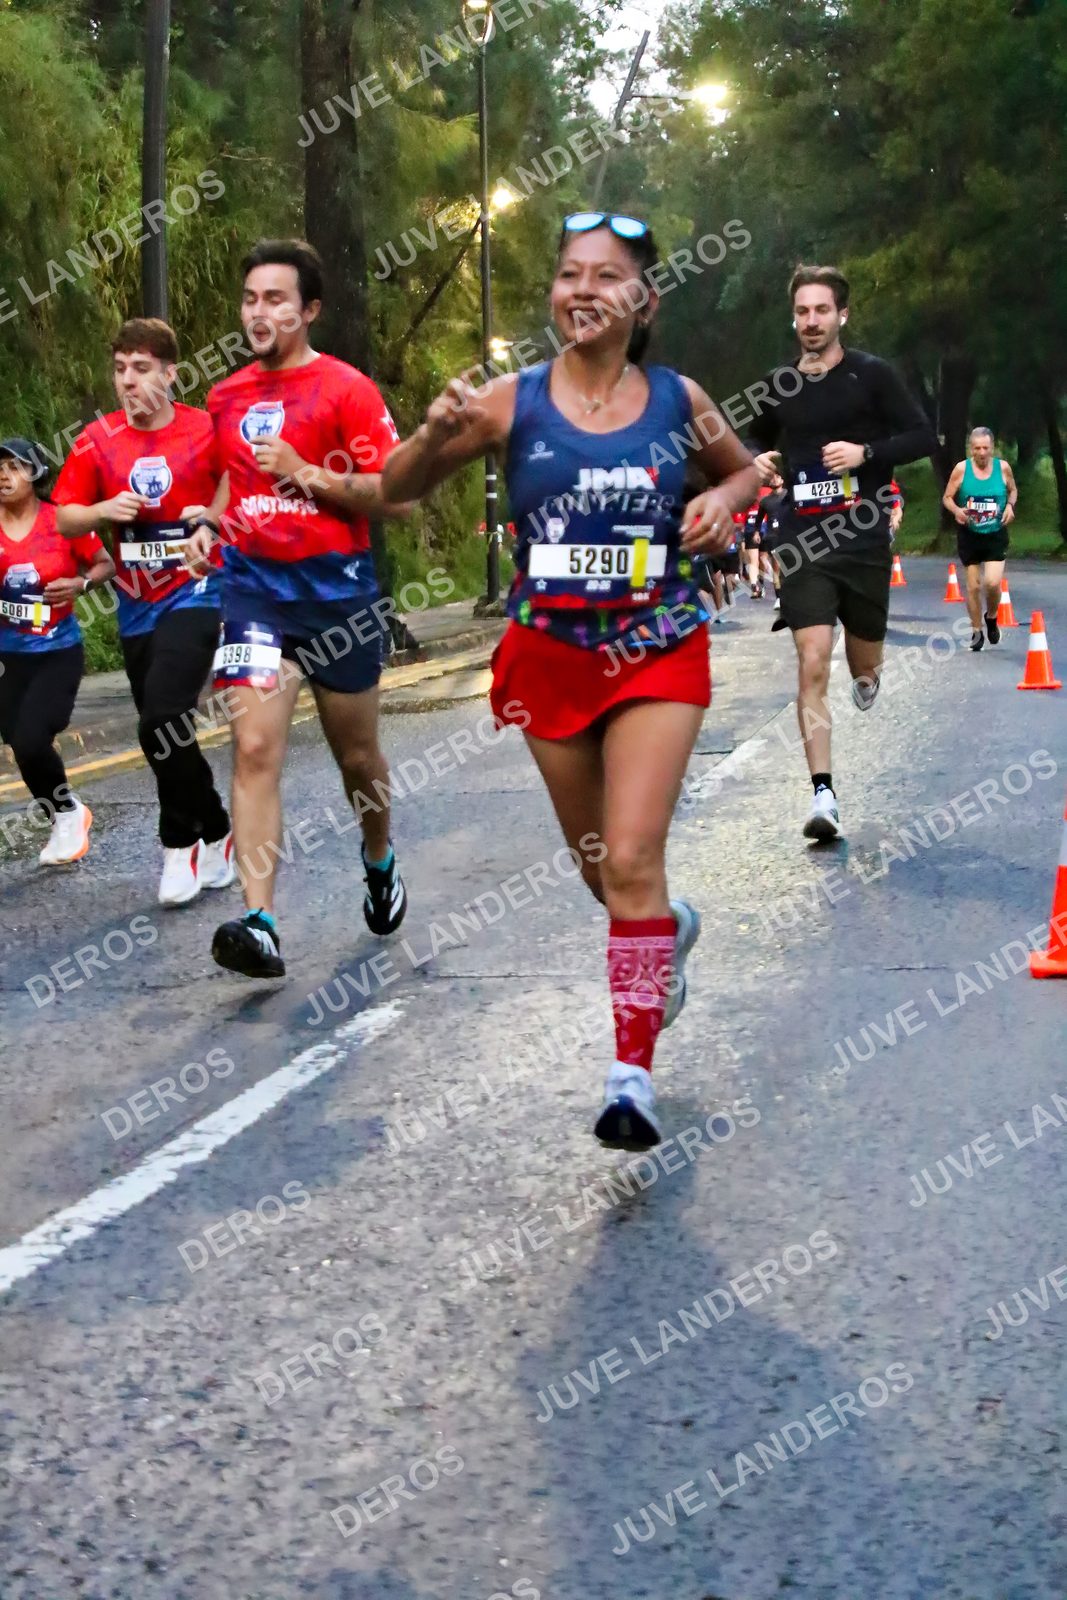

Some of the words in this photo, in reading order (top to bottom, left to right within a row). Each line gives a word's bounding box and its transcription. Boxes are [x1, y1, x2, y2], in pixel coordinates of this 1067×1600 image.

[811, 481, 840, 497] 4223
[569, 547, 629, 575] 5290
[2, 602, 28, 618] 5081
